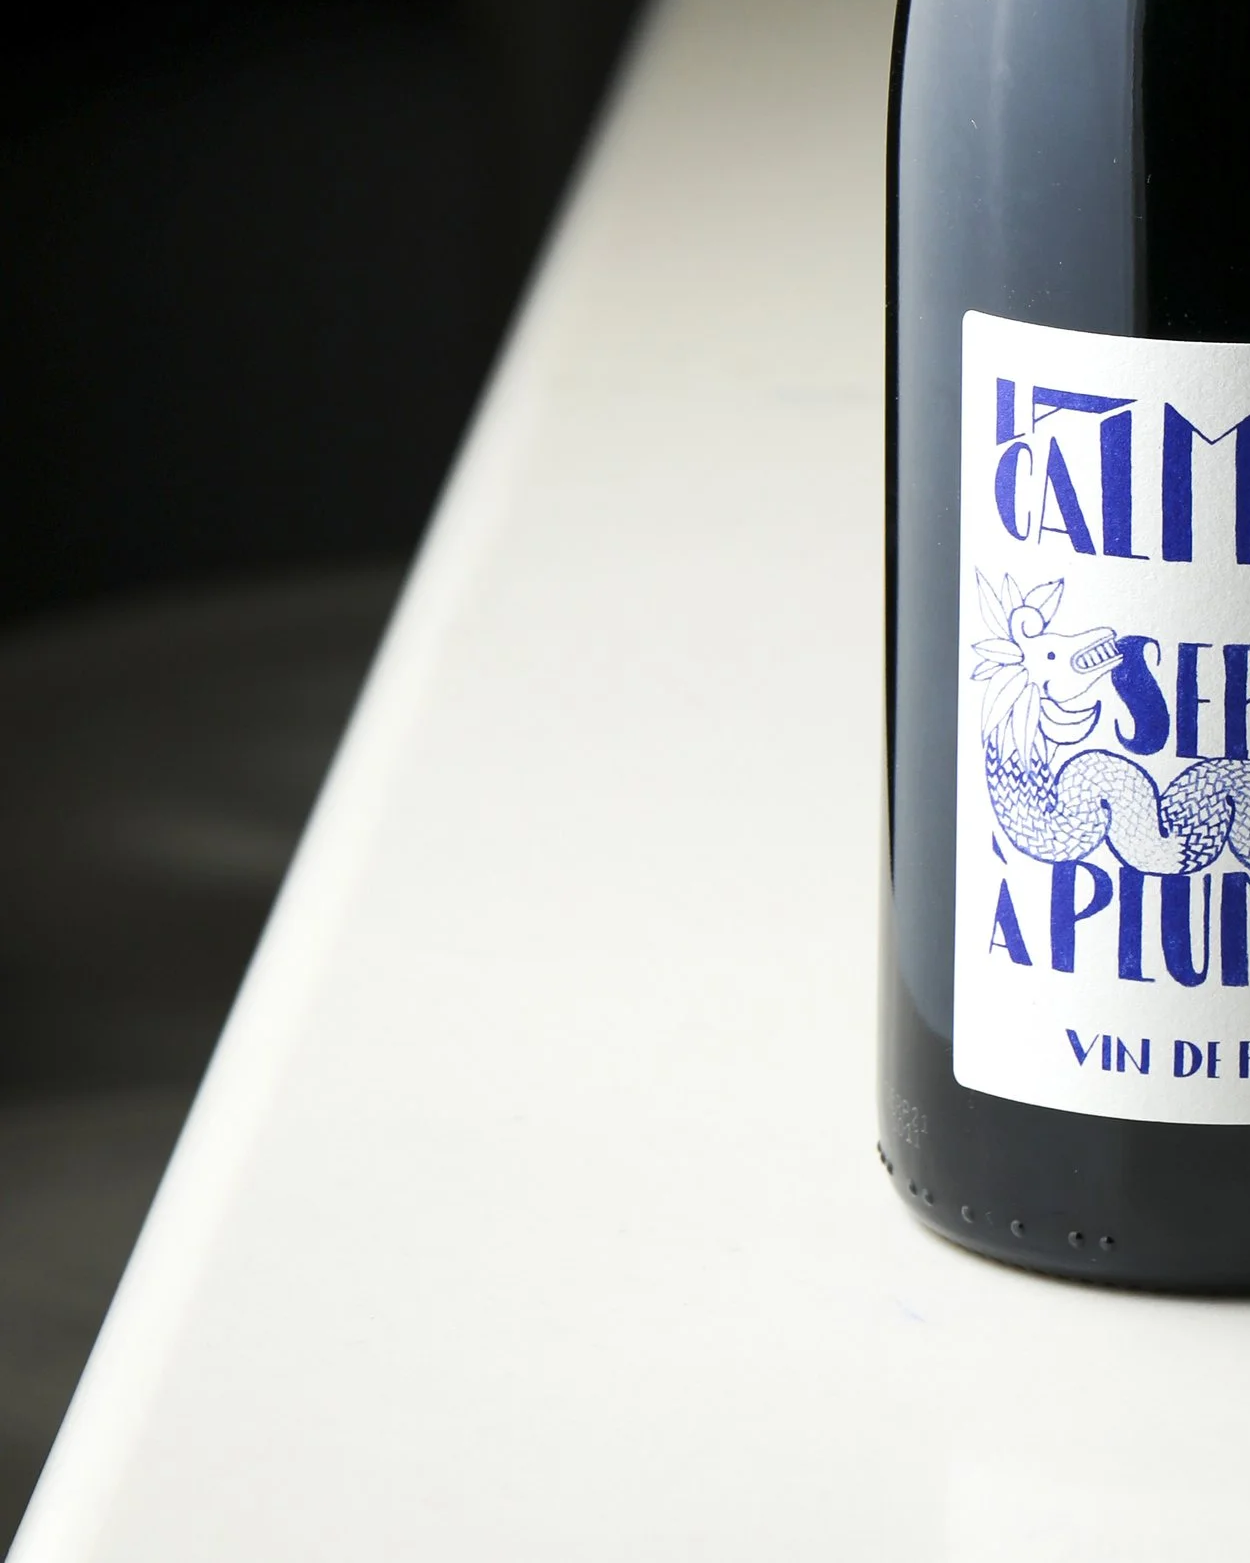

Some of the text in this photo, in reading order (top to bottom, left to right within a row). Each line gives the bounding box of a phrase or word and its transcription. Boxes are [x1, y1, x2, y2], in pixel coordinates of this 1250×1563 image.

[996, 378, 1138, 446] LA
[989, 831, 1033, 966] À
[1066, 1028, 1150, 1075] VIN
[1173, 1040, 1222, 1079] DE
